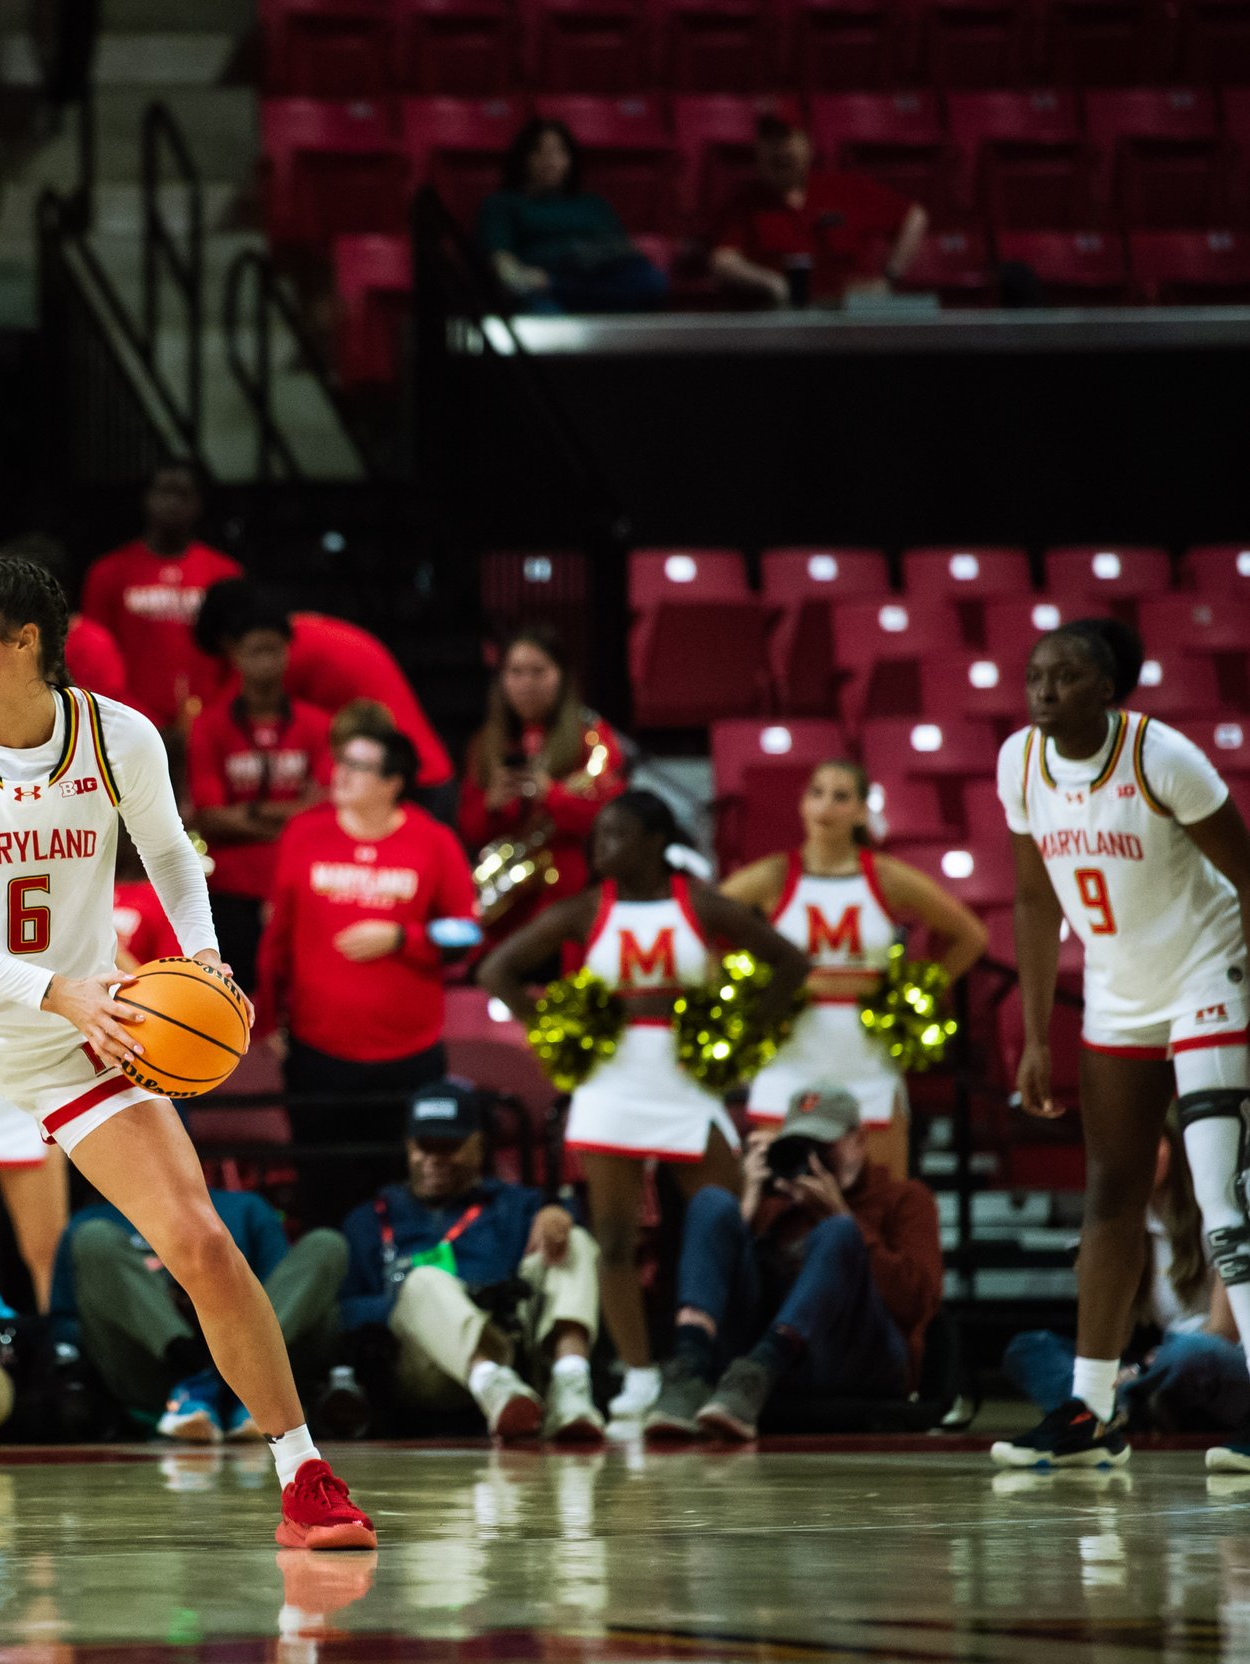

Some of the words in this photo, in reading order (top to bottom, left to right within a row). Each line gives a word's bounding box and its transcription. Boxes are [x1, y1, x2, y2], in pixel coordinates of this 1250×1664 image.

[1039, 829, 1145, 862] MARYLAND
[7, 874, 51, 955] 6
[1074, 867, 1118, 935] 9
[617, 926, 675, 983] M
[805, 903, 863, 957] M
[116, 1055, 198, 1098] Wilson
